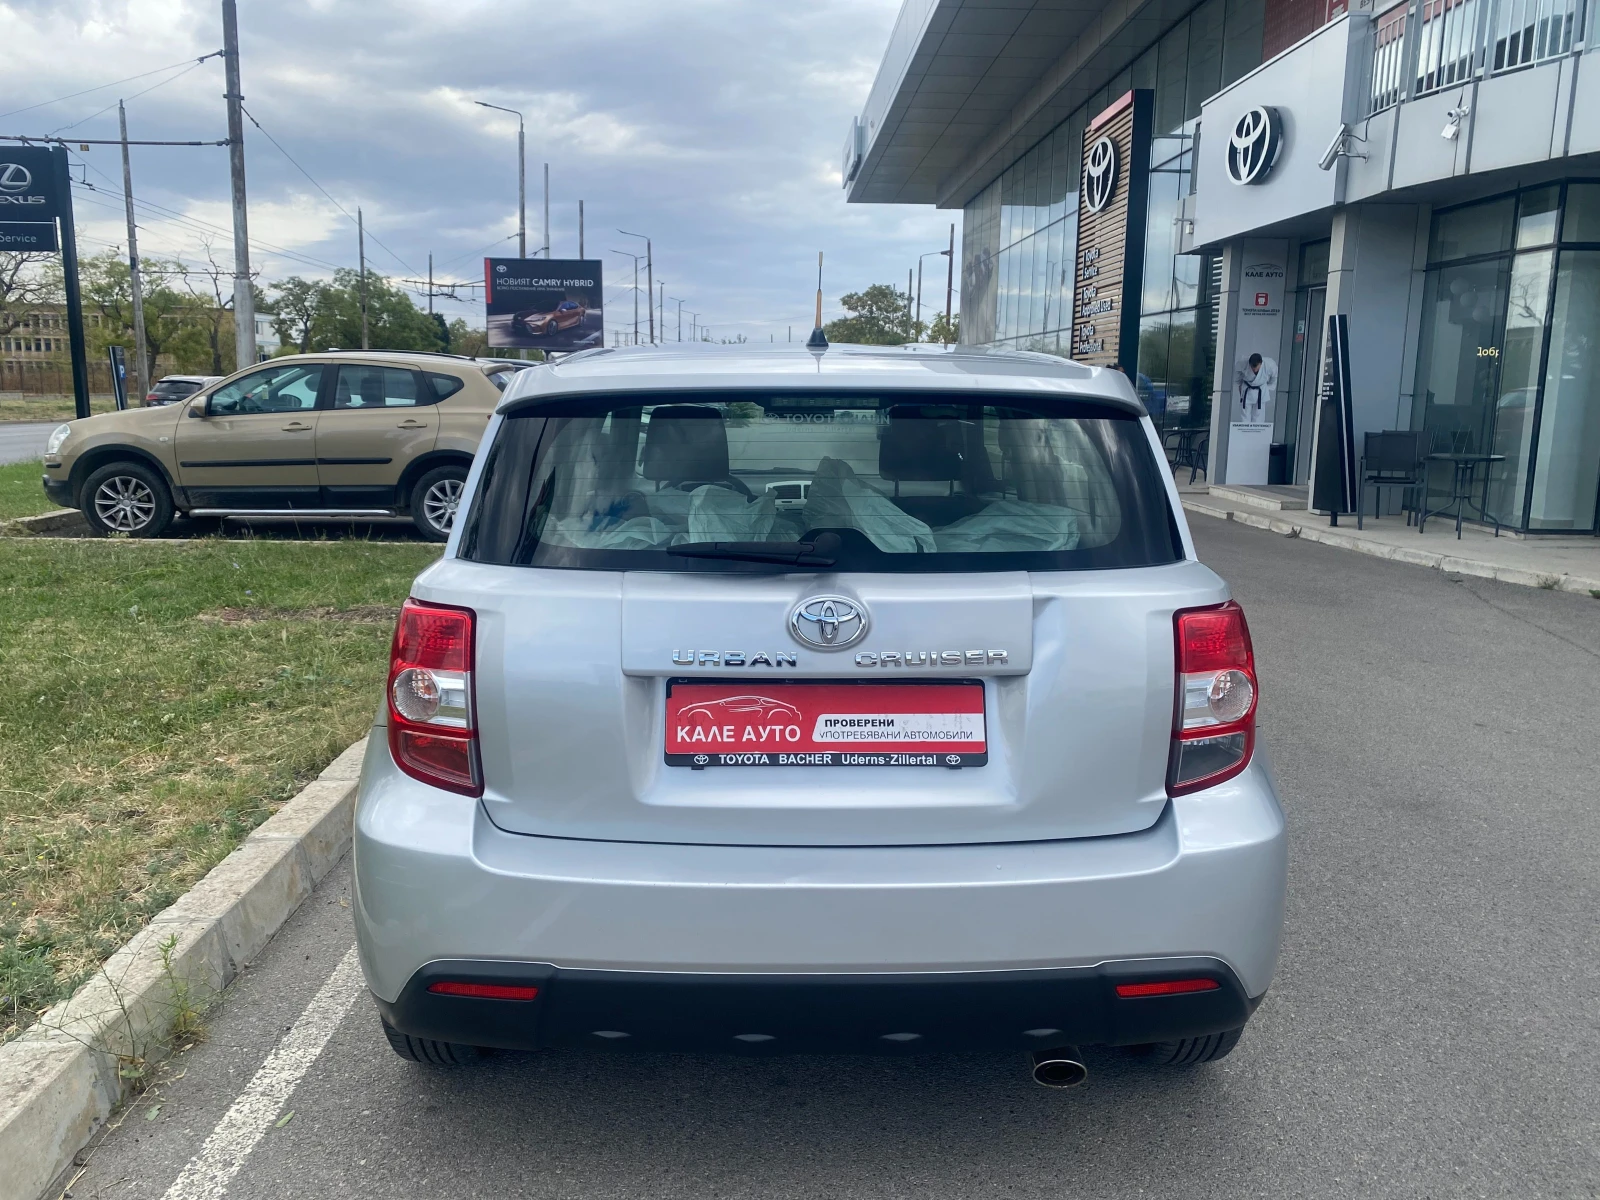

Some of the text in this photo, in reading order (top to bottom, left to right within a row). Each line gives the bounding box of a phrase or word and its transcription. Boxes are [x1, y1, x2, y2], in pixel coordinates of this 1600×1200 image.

[0, 195, 46, 204] EXUS
[0, 232, 37, 243] Service
[1085, 248, 1099, 264] Toyota
[1084, 265, 1098, 279] Service
[496, 277, 594, 287] НОВИЯТ CAMRY HYBRID
[1083, 286, 1097, 301] Toyota
[1081, 324, 1095, 339] Toyota
[672, 649, 1009, 668] URBAN CRUISER
[824, 718, 895, 728] ПРОВЕРЕНИ
[676, 725, 801, 743] КАЛЕ АУТО
[819, 730, 973, 740] УПОТРЕБЯВАНИ АВТОМОБИЛИ
[718, 754, 937, 765] TOYOTA BACHER Uderns-Zillertal
